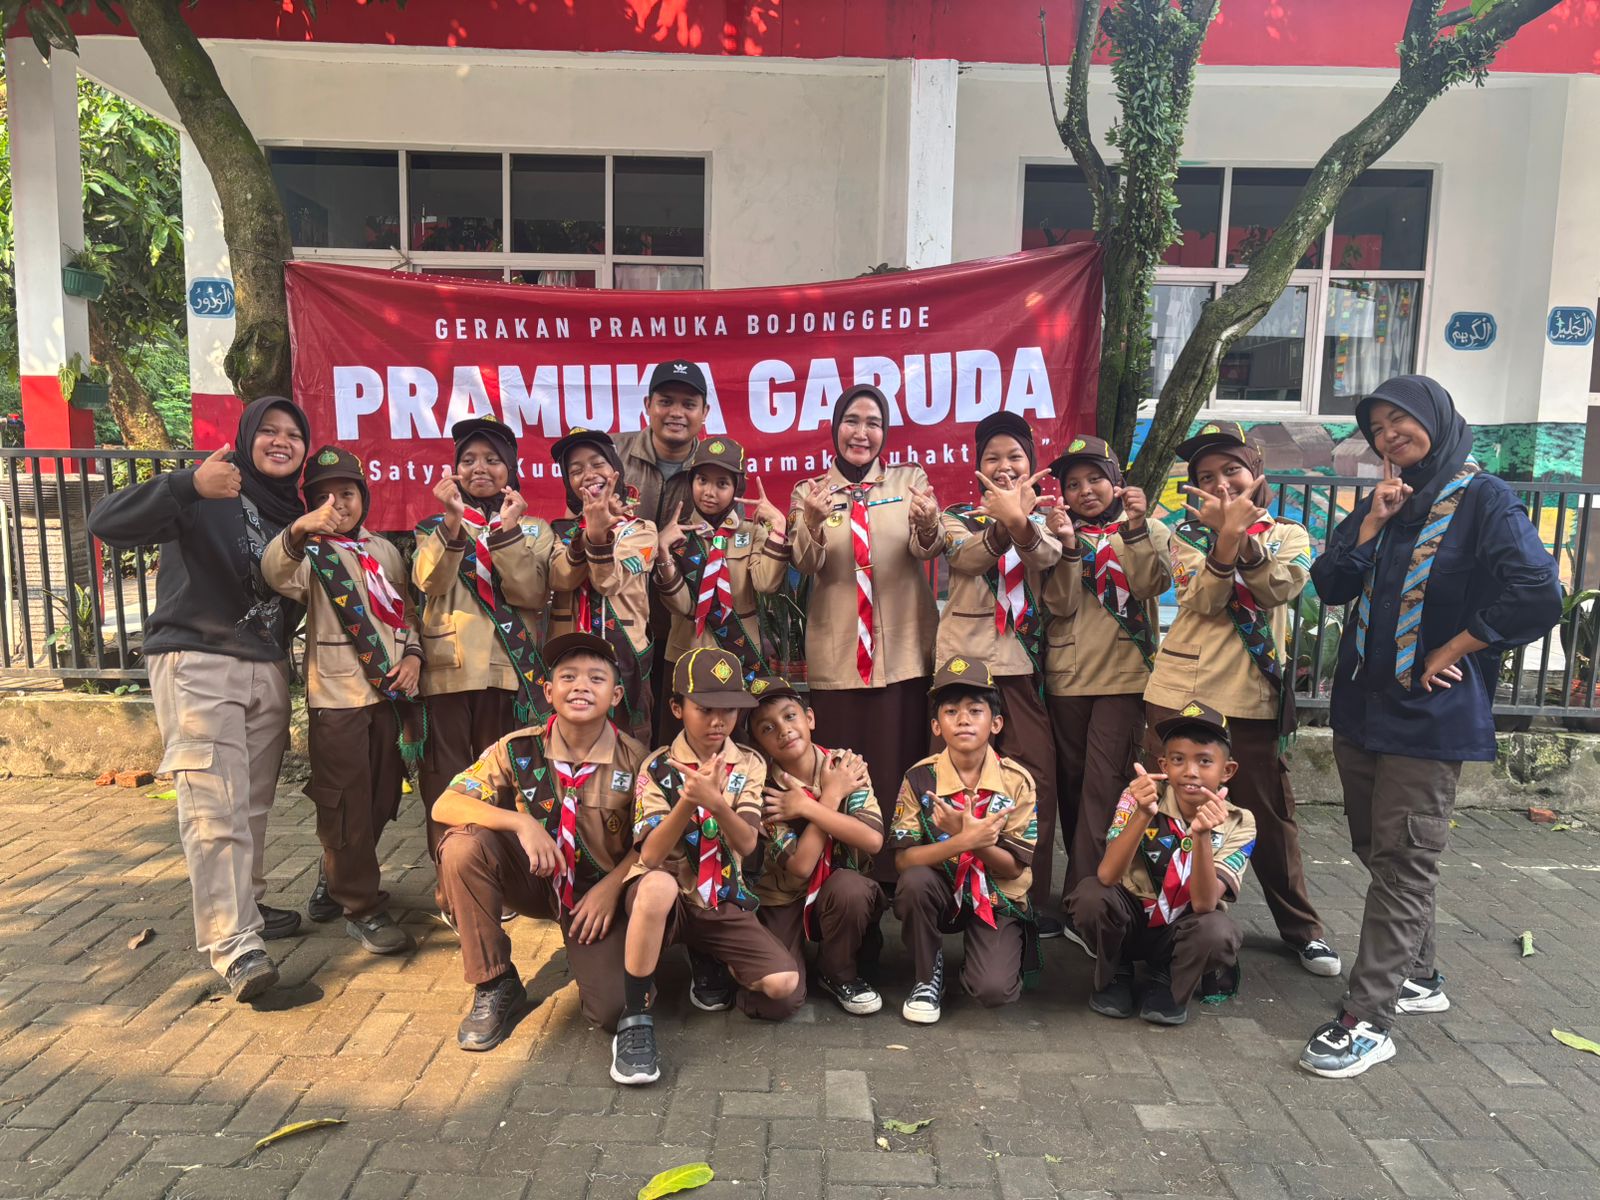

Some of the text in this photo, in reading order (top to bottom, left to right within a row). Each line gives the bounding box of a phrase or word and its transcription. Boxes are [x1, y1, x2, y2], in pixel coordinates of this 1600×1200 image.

[434, 306, 930, 340] GERAKAN PRAMUKA BOJONGGEDE
[748, 346, 1057, 435] GARUDA
[746, 449, 834, 473] armak
